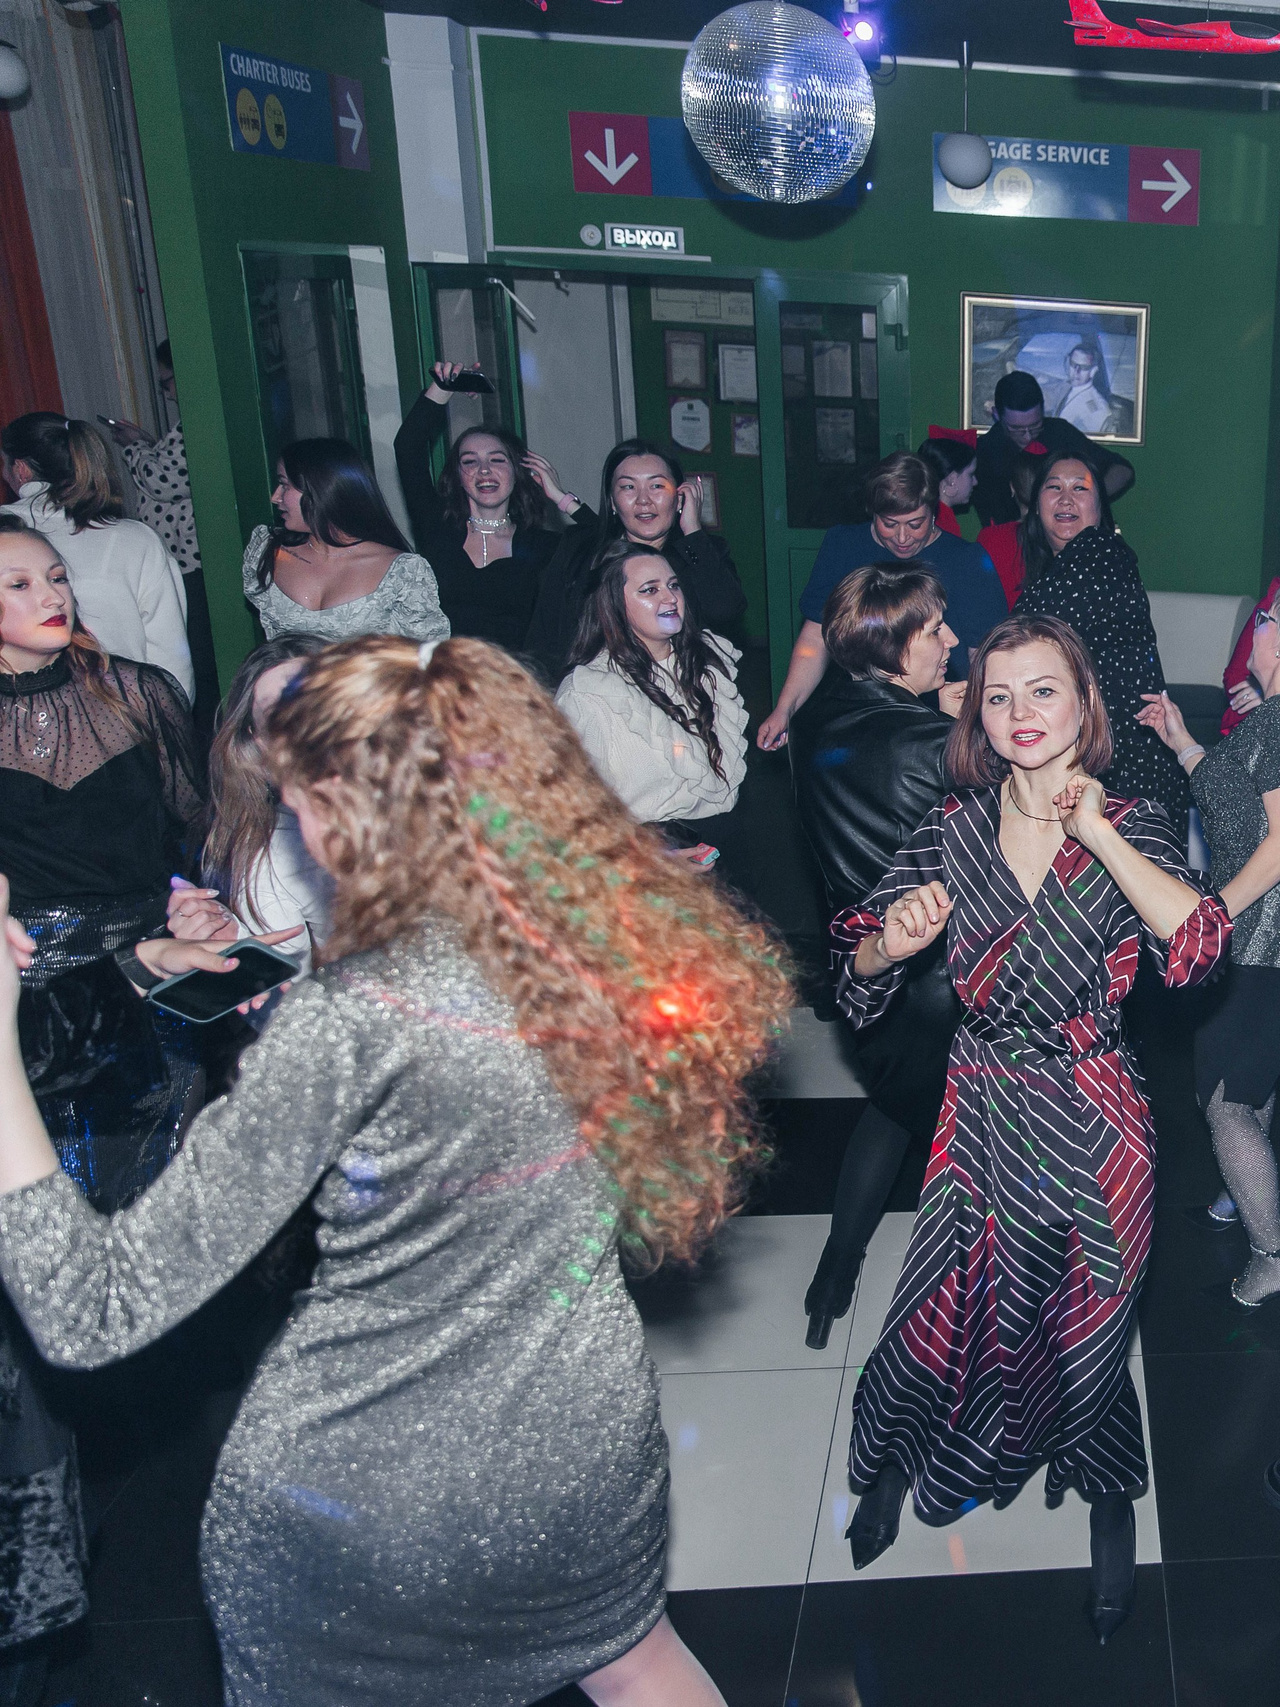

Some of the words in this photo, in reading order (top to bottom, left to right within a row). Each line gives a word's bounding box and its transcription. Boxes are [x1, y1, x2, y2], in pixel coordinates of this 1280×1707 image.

[229, 53, 280, 86] CHARTER
[280, 66, 312, 93] BUSES
[987, 141, 1032, 161] GAGE
[1036, 144, 1110, 166] SERVICE
[612, 228, 677, 248] ВЫХОД
